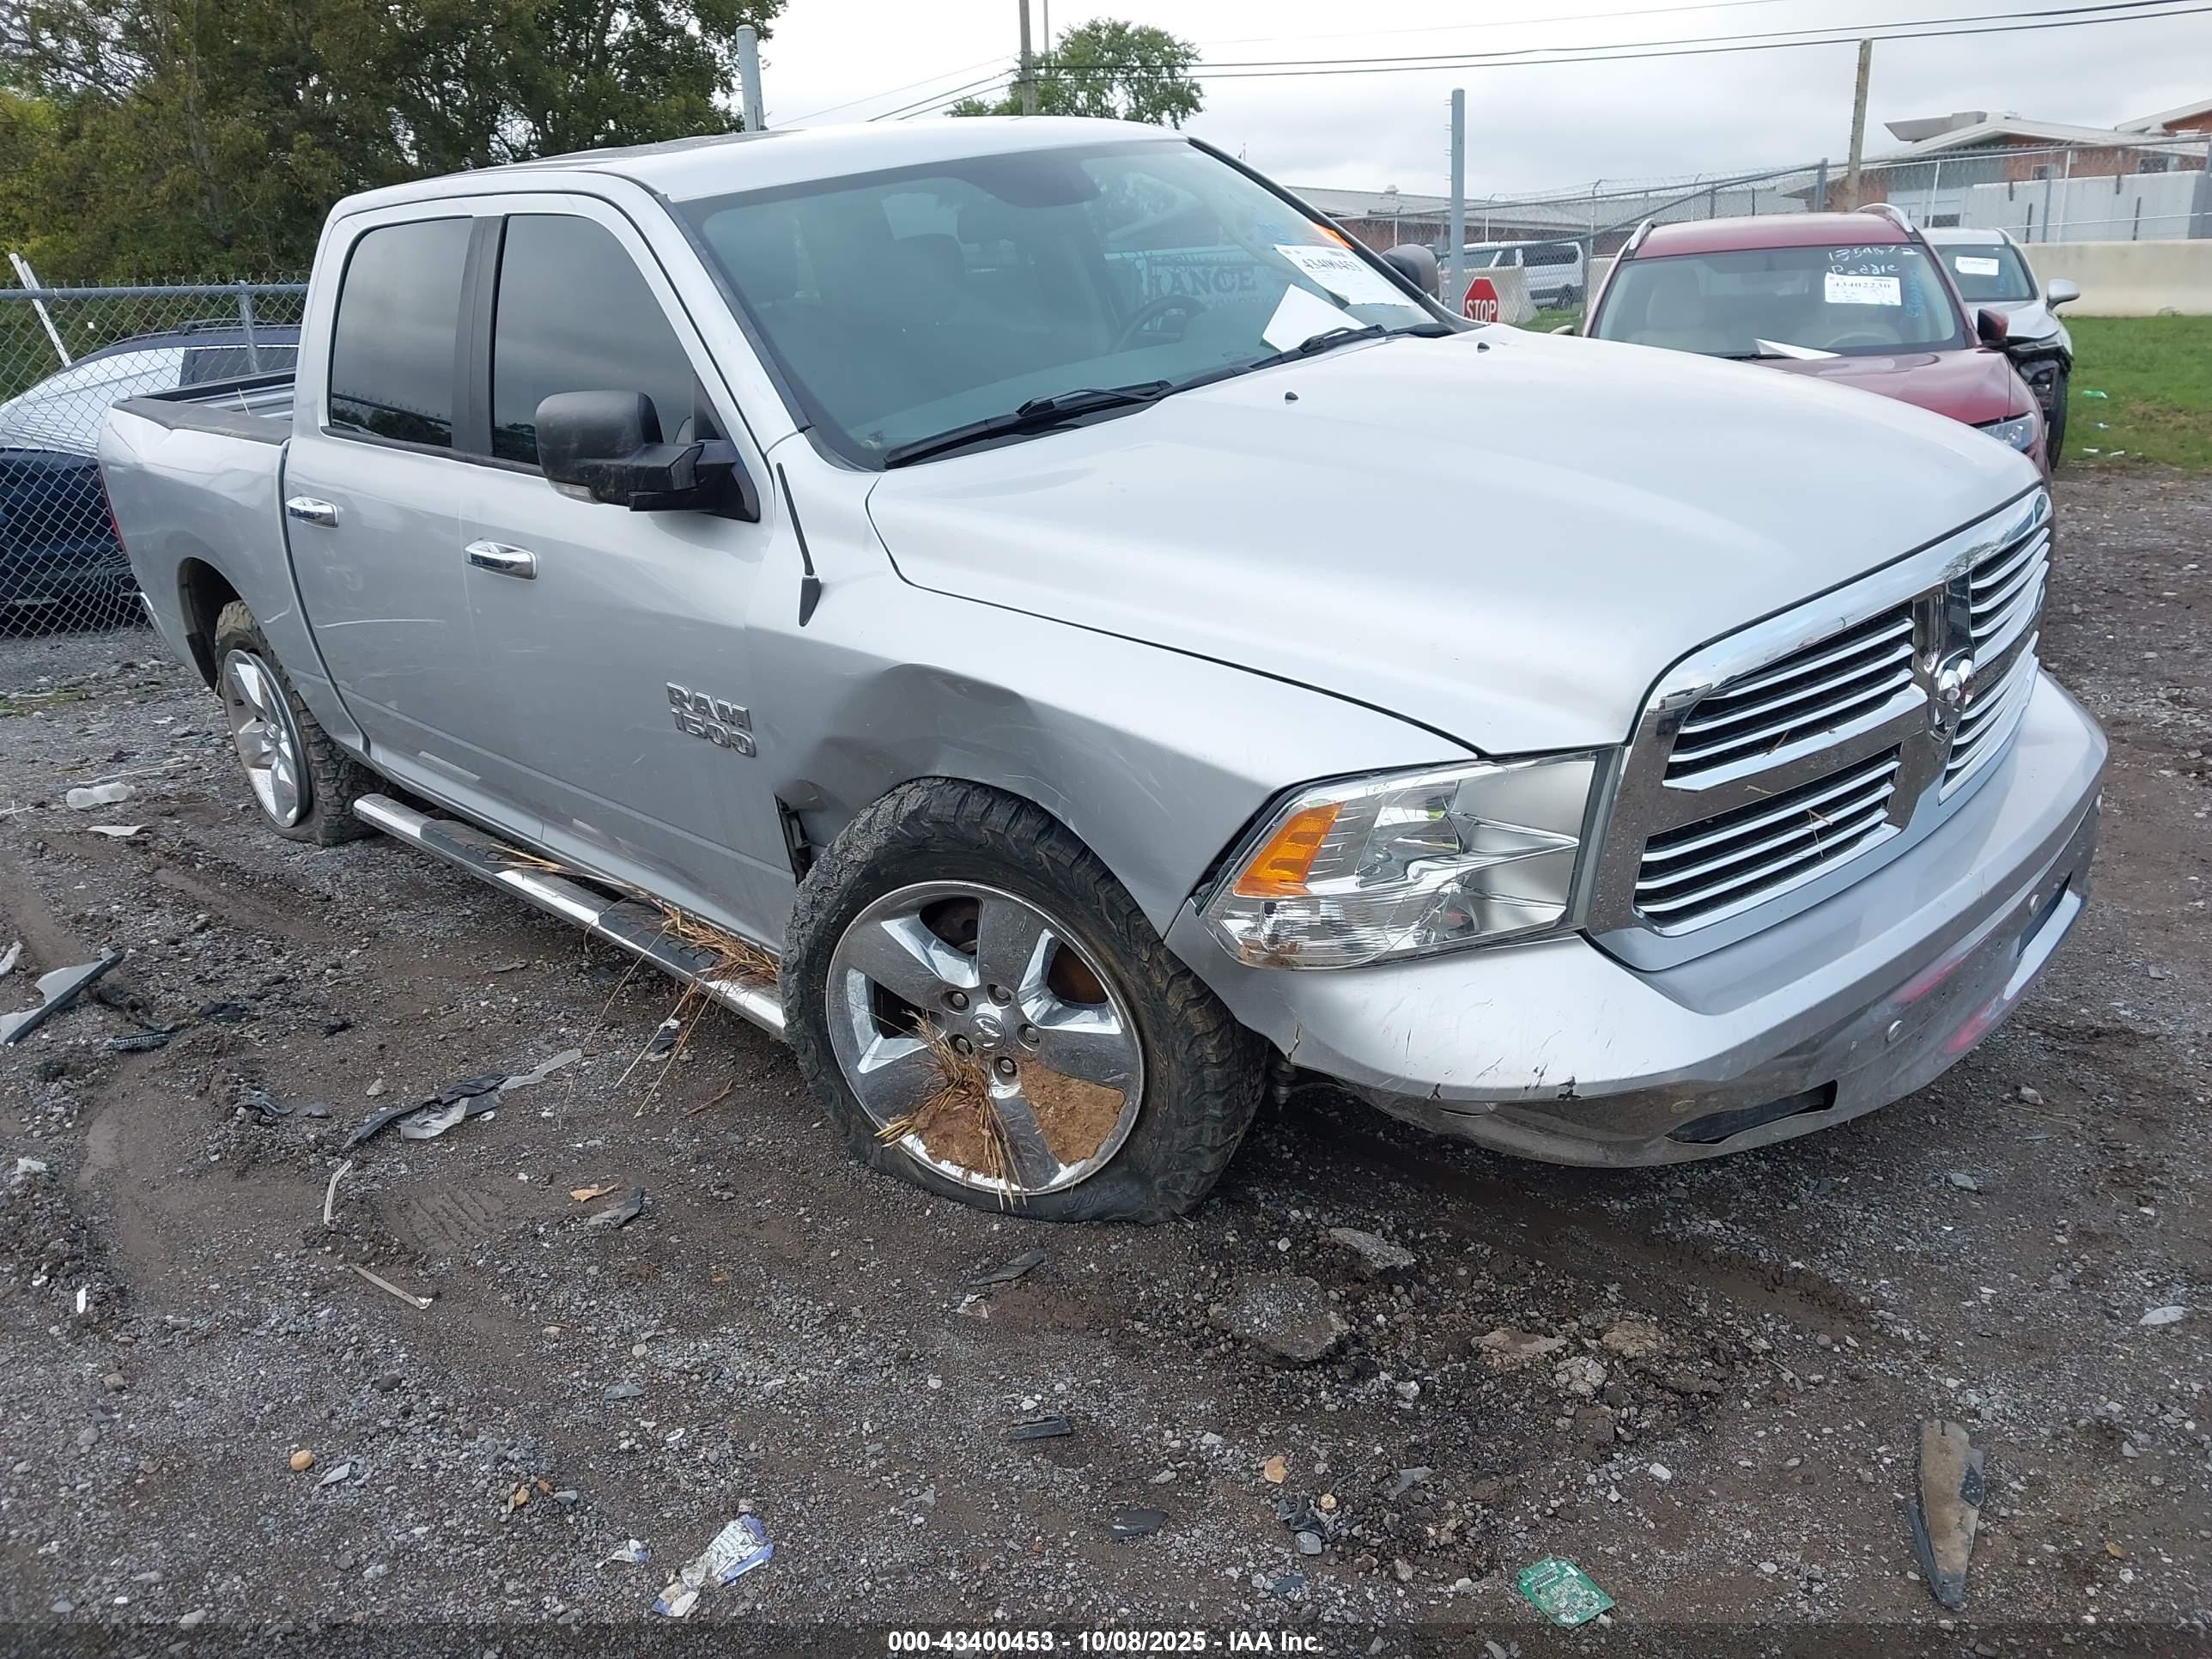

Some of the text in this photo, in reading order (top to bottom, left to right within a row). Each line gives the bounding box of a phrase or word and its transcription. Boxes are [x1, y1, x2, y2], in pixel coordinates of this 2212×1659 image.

[1466, 299, 1497, 323] STOP
[666, 682, 752, 732] RAM
[671, 707, 757, 757] 1500
